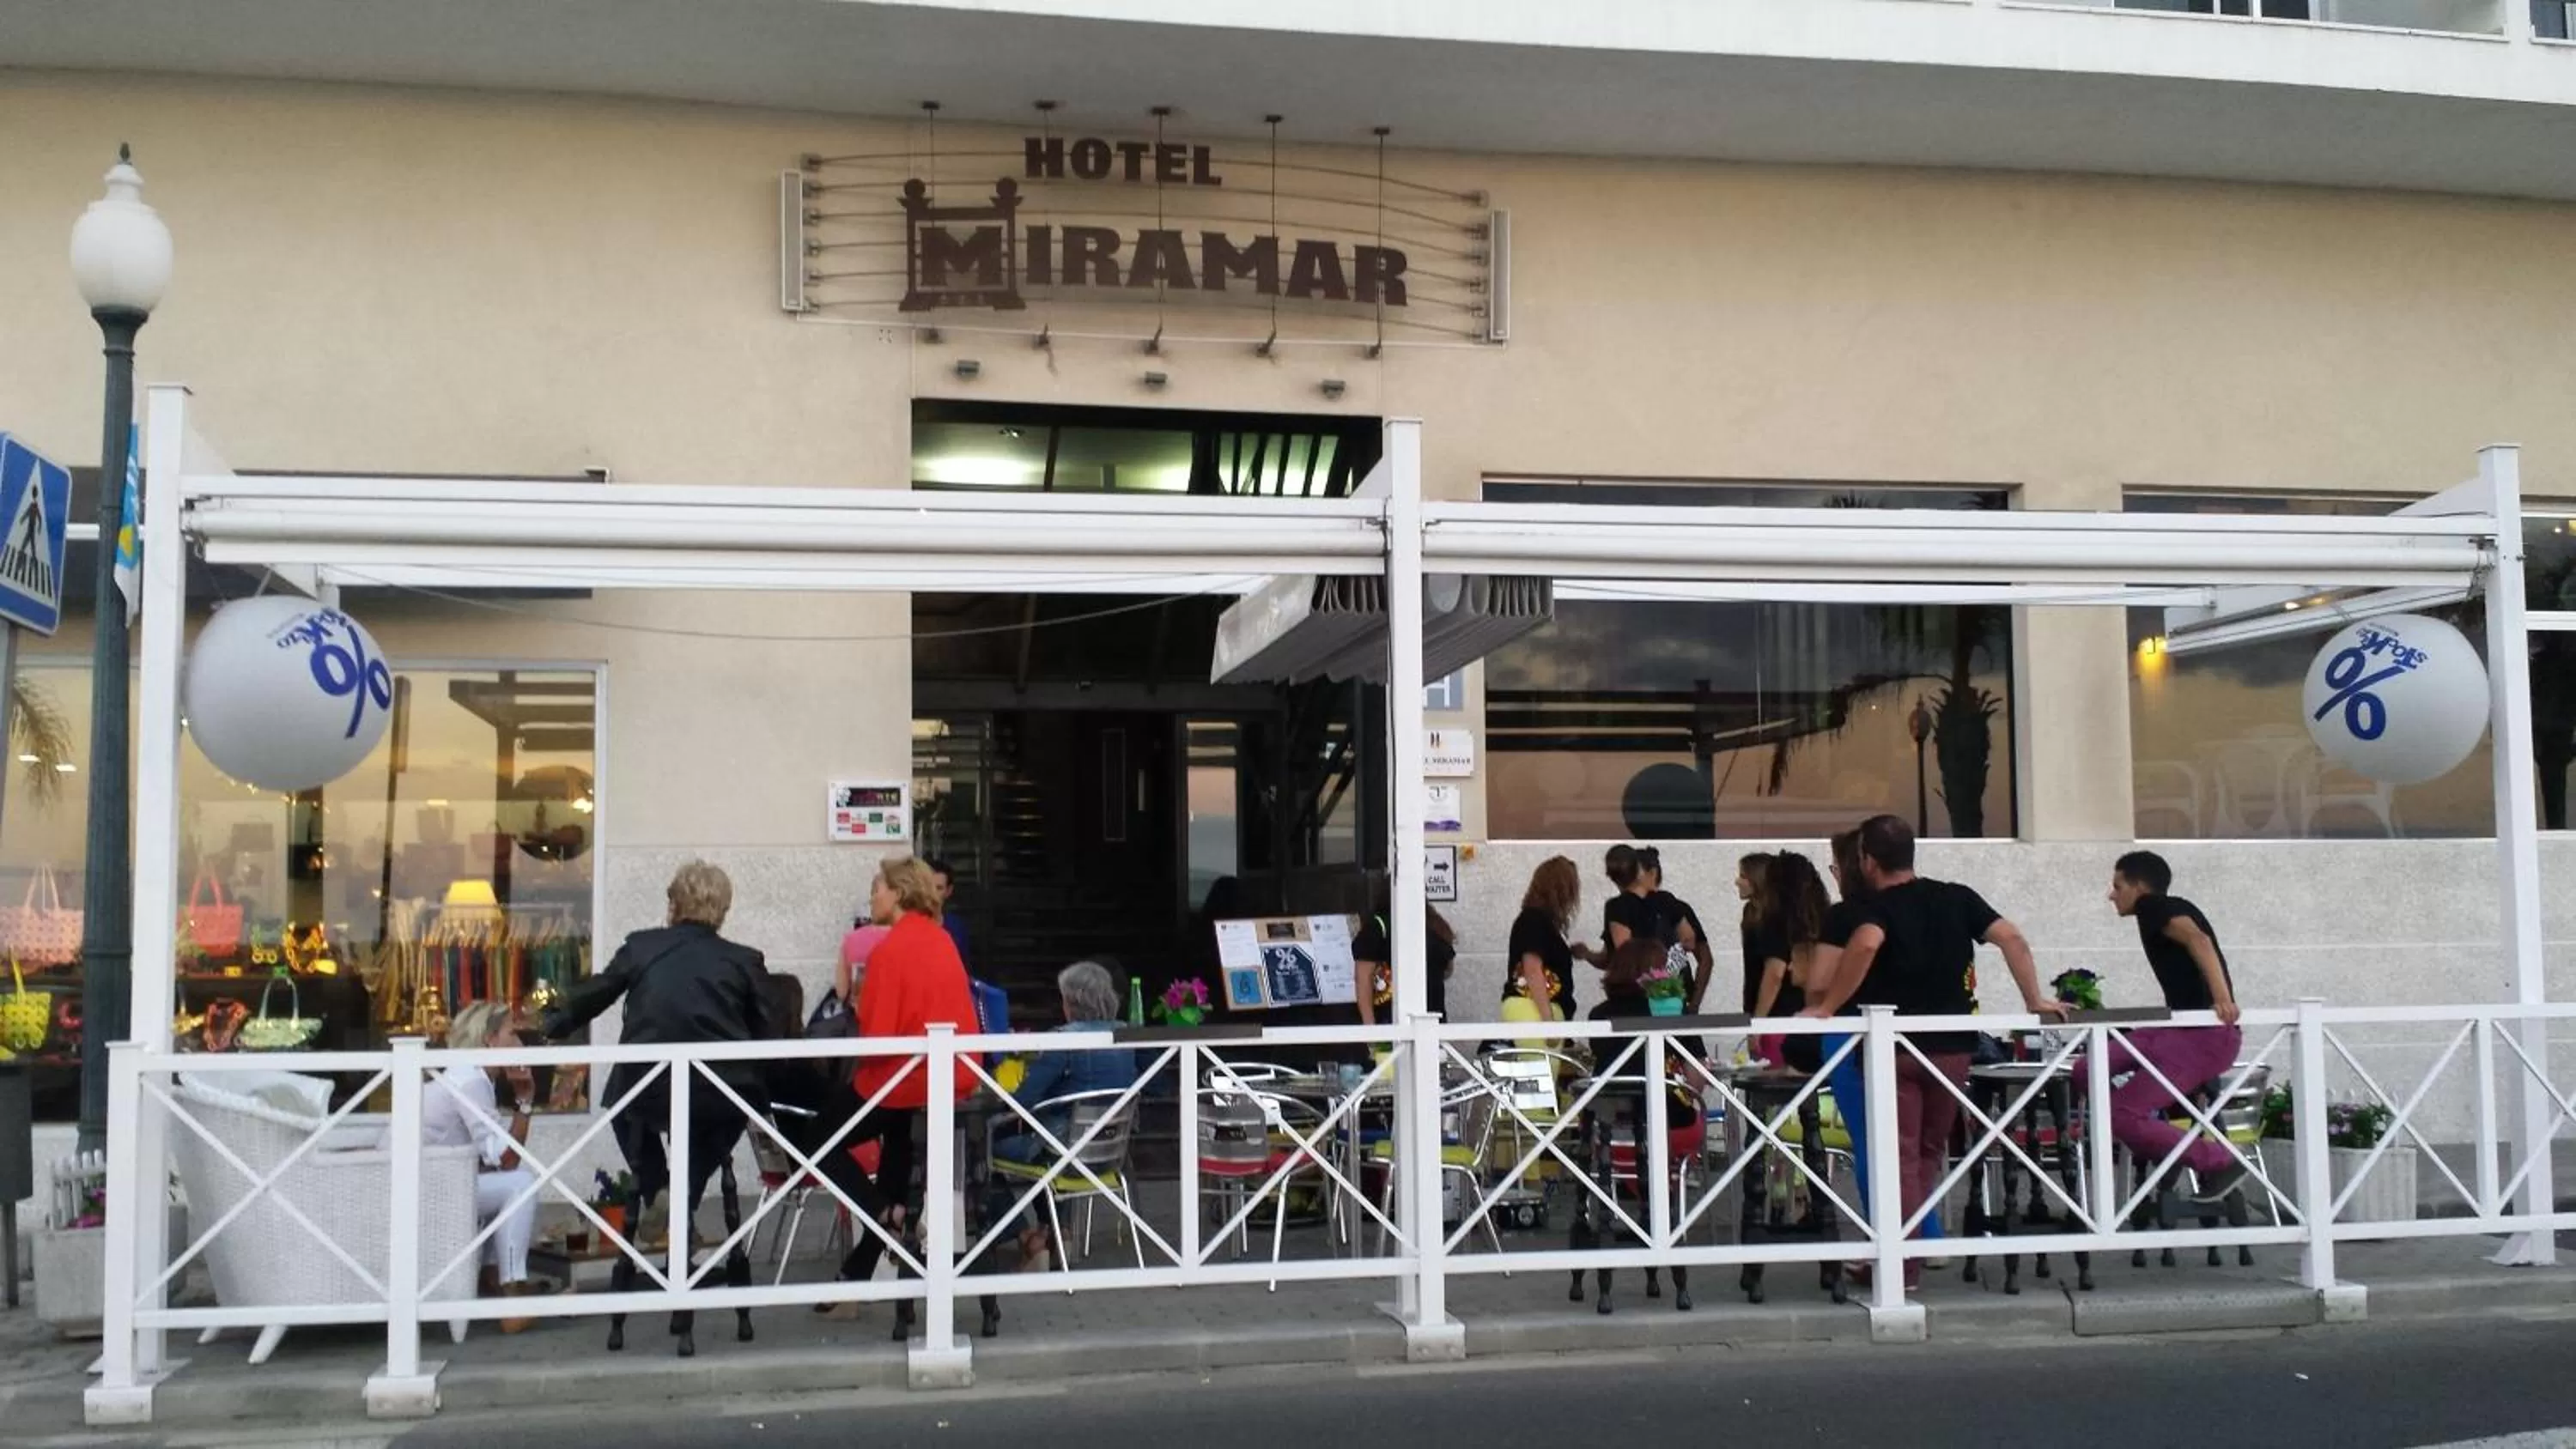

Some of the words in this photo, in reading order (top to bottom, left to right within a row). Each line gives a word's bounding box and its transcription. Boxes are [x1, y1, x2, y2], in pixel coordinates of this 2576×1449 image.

[1025, 137, 1222, 186] HOTEL
[920, 225, 1408, 306] MIRAMAR
[1428, 875, 1446, 884] CALL
